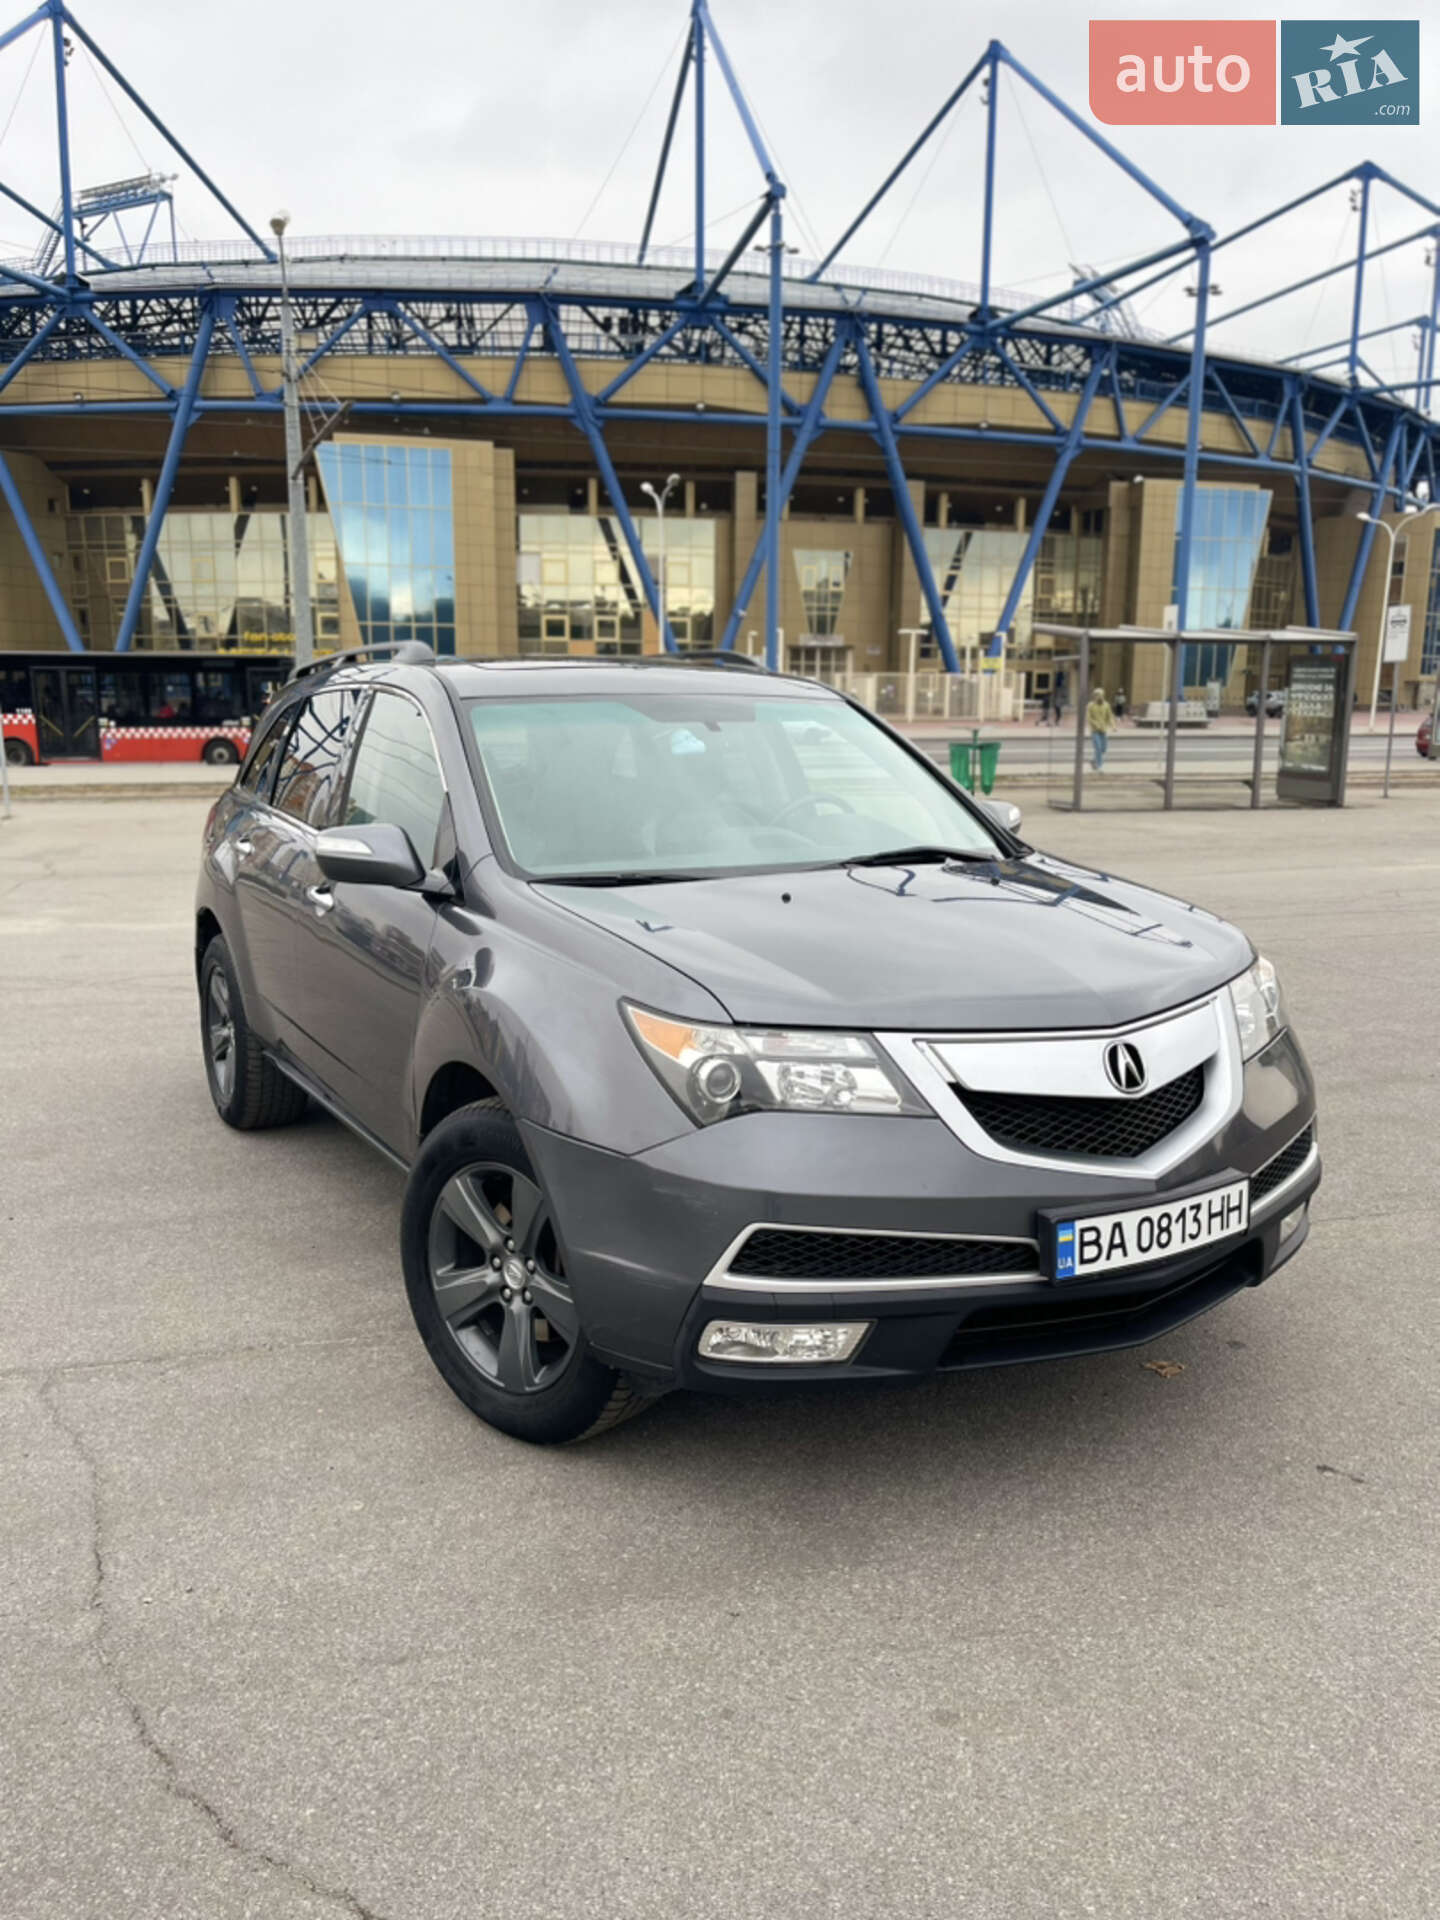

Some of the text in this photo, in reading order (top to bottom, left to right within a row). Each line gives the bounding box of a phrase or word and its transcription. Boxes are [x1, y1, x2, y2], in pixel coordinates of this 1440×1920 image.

[1078, 1189, 1244, 1266] BA 0813 HH
[1057, 1256, 1073, 1269] UA
